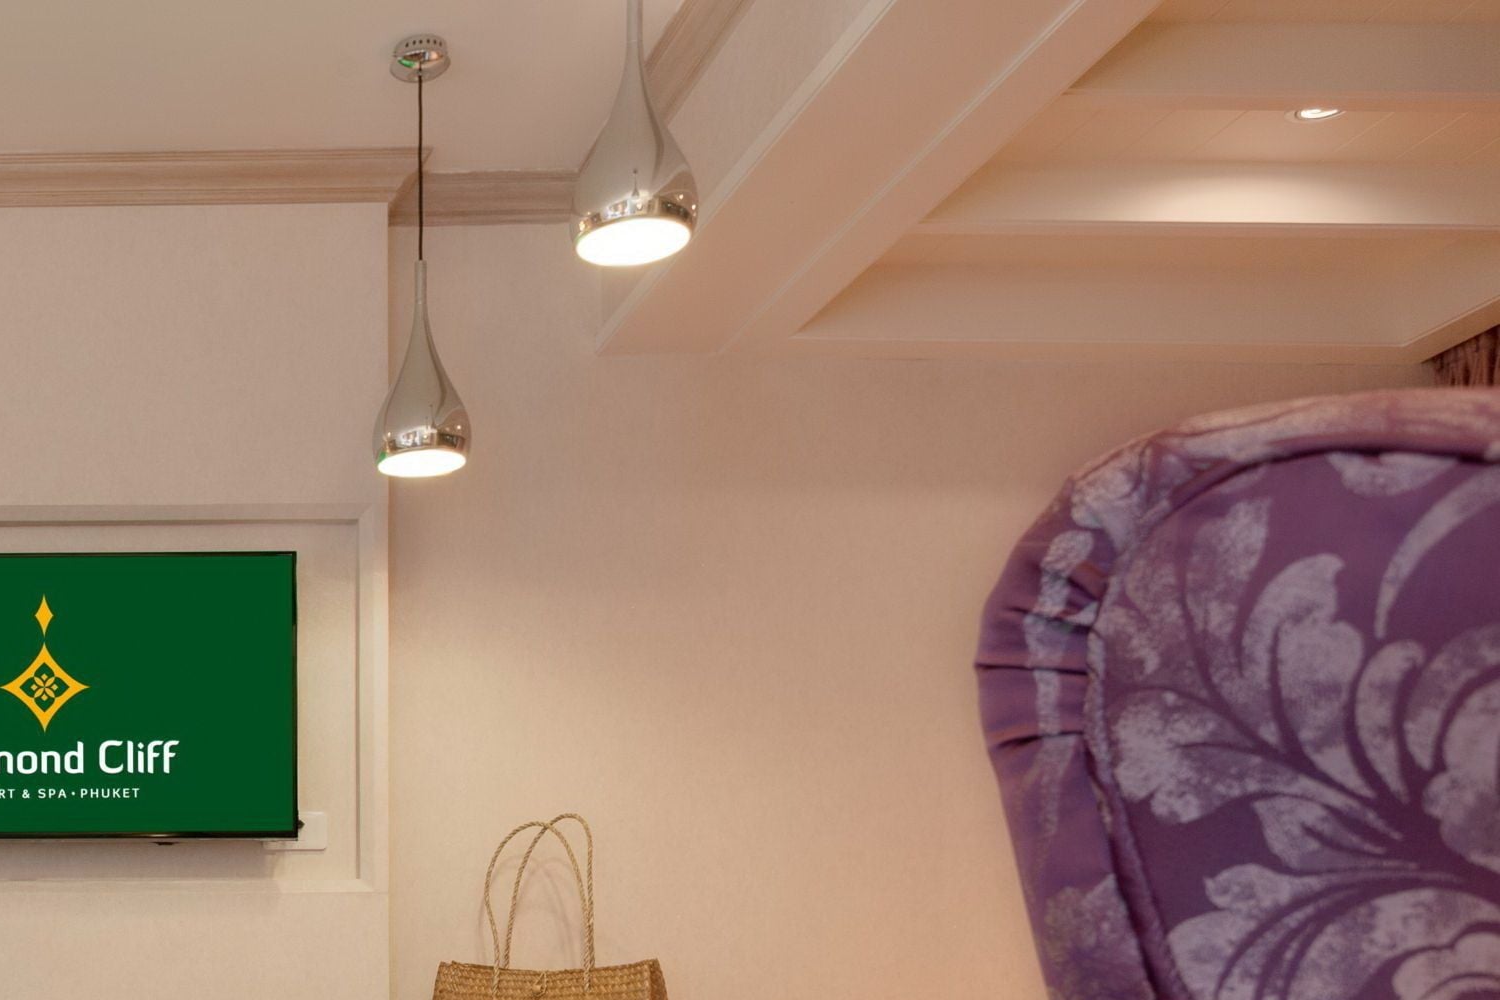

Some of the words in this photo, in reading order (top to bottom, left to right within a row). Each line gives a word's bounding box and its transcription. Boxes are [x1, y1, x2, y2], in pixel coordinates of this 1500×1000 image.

[98, 739, 180, 774] Cliff
[21, 788, 30, 799] &
[80, 787, 140, 799] PHUKET
